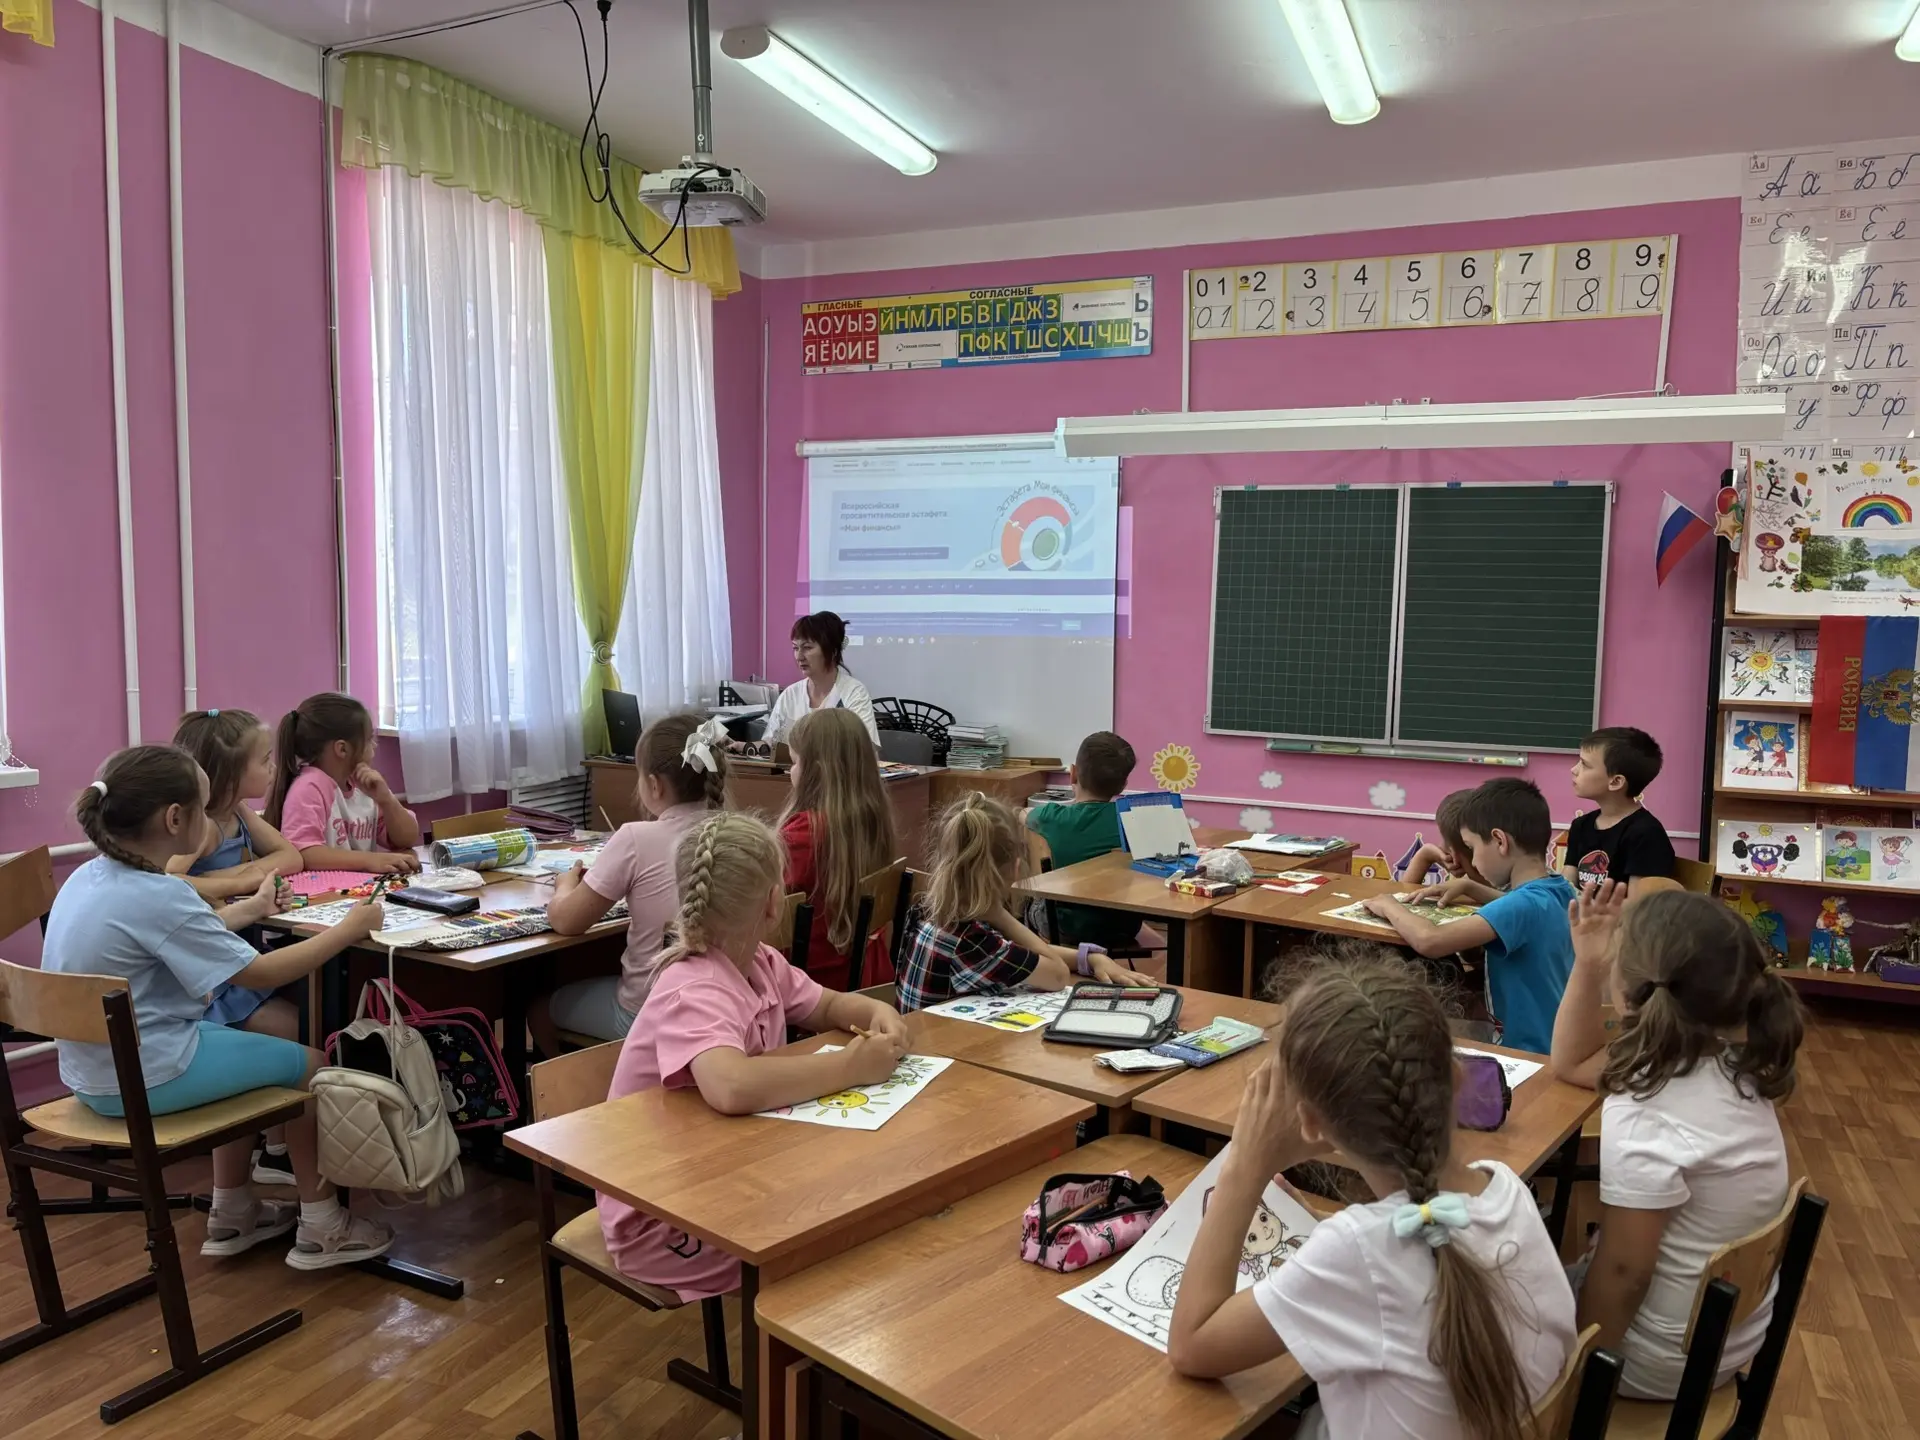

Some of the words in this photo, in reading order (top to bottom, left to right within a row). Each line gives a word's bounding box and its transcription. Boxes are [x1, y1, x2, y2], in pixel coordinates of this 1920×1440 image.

[1759, 156, 1791, 199] А
[1801, 172, 1822, 197] а
[1853, 156, 1886, 190] Б
[1768, 211, 1793, 245] Е
[1196, 278, 1209, 298] 0
[1217, 276, 1226, 296] 1
[1253, 271, 1267, 292] 2
[1303, 268, 1317, 290] 3
[1353, 263, 1369, 286] 4
[1406, 260, 1421, 283] 5
[1460, 257, 1476, 279] 6
[1518, 252, 1534, 275] 7
[1574, 247, 1591, 271] 8
[1635, 243, 1652, 267] 9
[1852, 264, 1884, 310] К
[1888, 280, 1908, 308] к
[817, 301, 863, 311] ГЛАСНЫЕ
[969, 287, 1034, 300] СОГЛАСНЫЕ
[1256, 298, 1275, 330] 2
[1305, 295, 1325, 327] 3
[1357, 292, 1377, 324] 4
[1409, 289, 1429, 321] 5
[1463, 285, 1484, 318] 6
[1522, 281, 1541, 315] 7
[1576, 277, 1599, 312] 8
[1636, 273, 1660, 309] 9
[1834, 327, 1849, 339] Пп
[1844, 324, 1887, 370] П
[1886, 344, 1909, 369] п
[1838, 656, 1862, 732] РОССИЯ
[1365, 868, 1372, 878] 5
